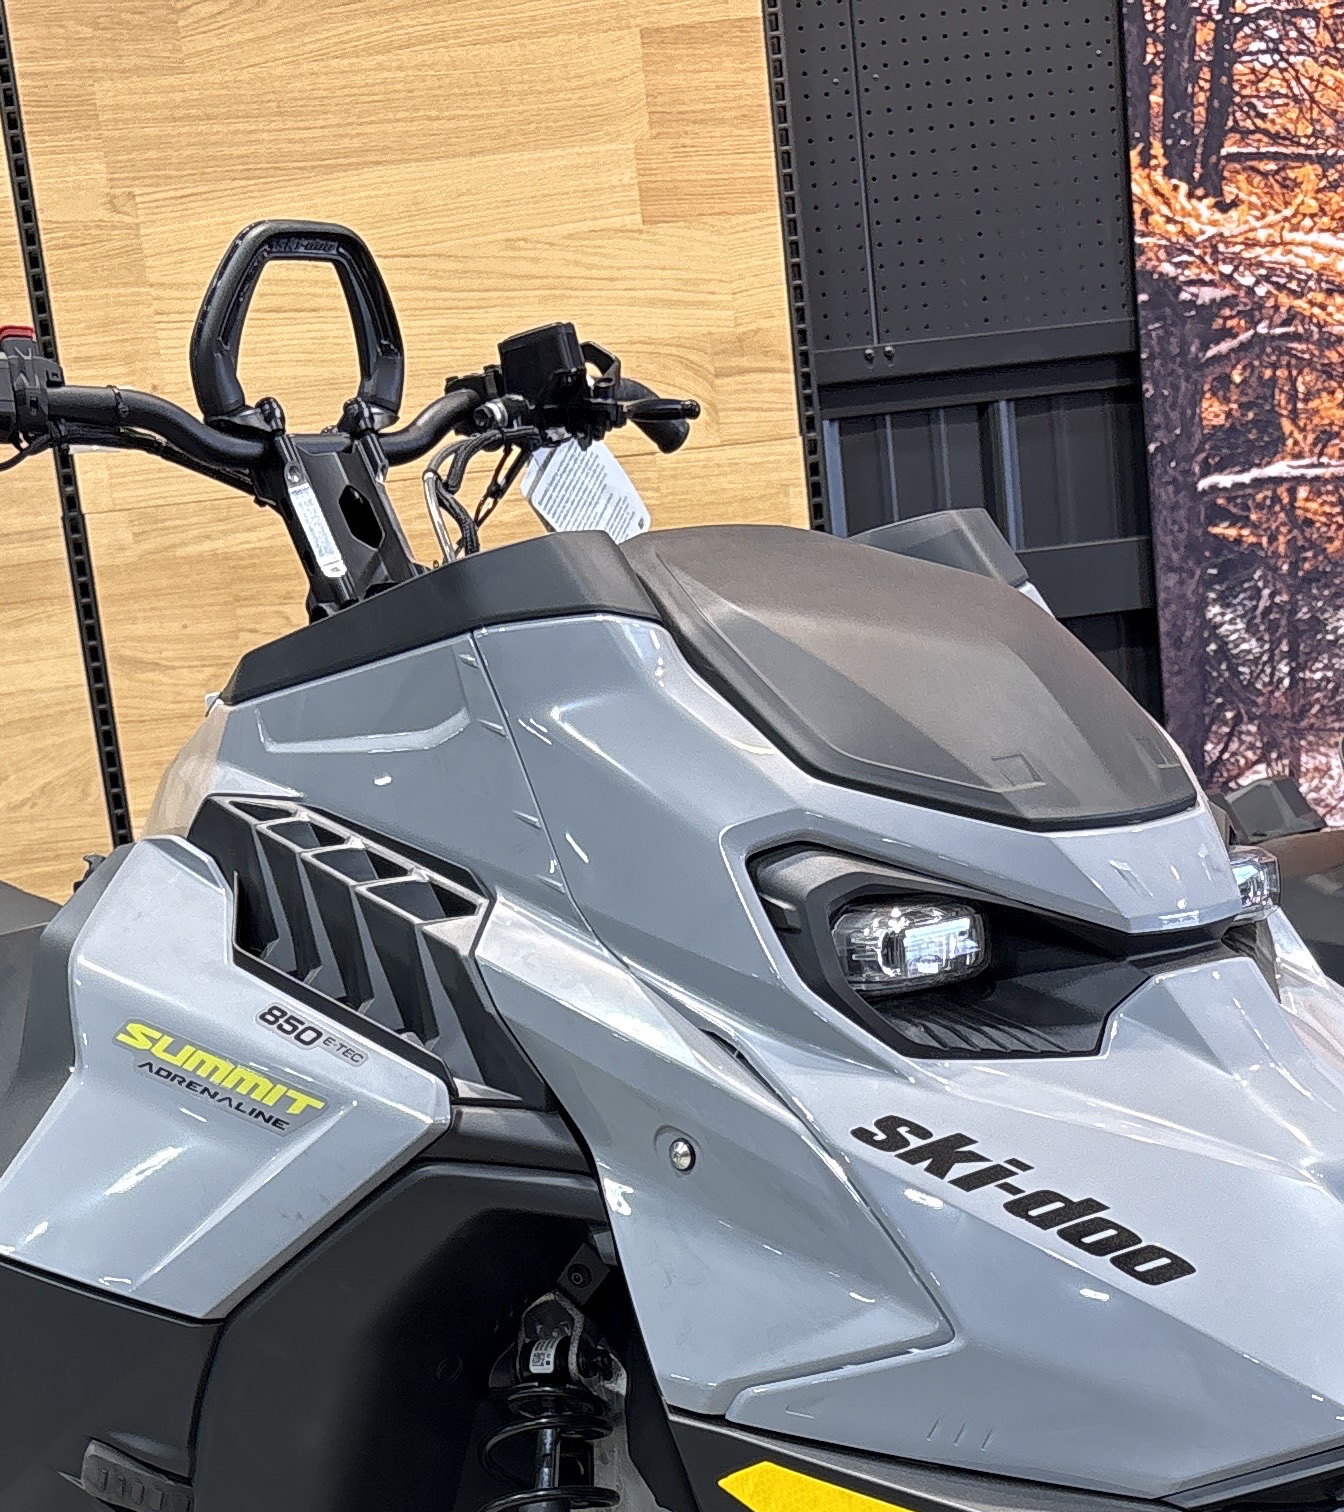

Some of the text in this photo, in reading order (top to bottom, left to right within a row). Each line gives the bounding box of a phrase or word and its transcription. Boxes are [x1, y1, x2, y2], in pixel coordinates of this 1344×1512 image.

[116, 1022, 326, 1115] SUMMIT
[258, 1005, 364, 1064] 850 E-TEC
[137, 1061, 291, 1131] ADRENALINE
[850, 1114, 1197, 1286] ski-doo
